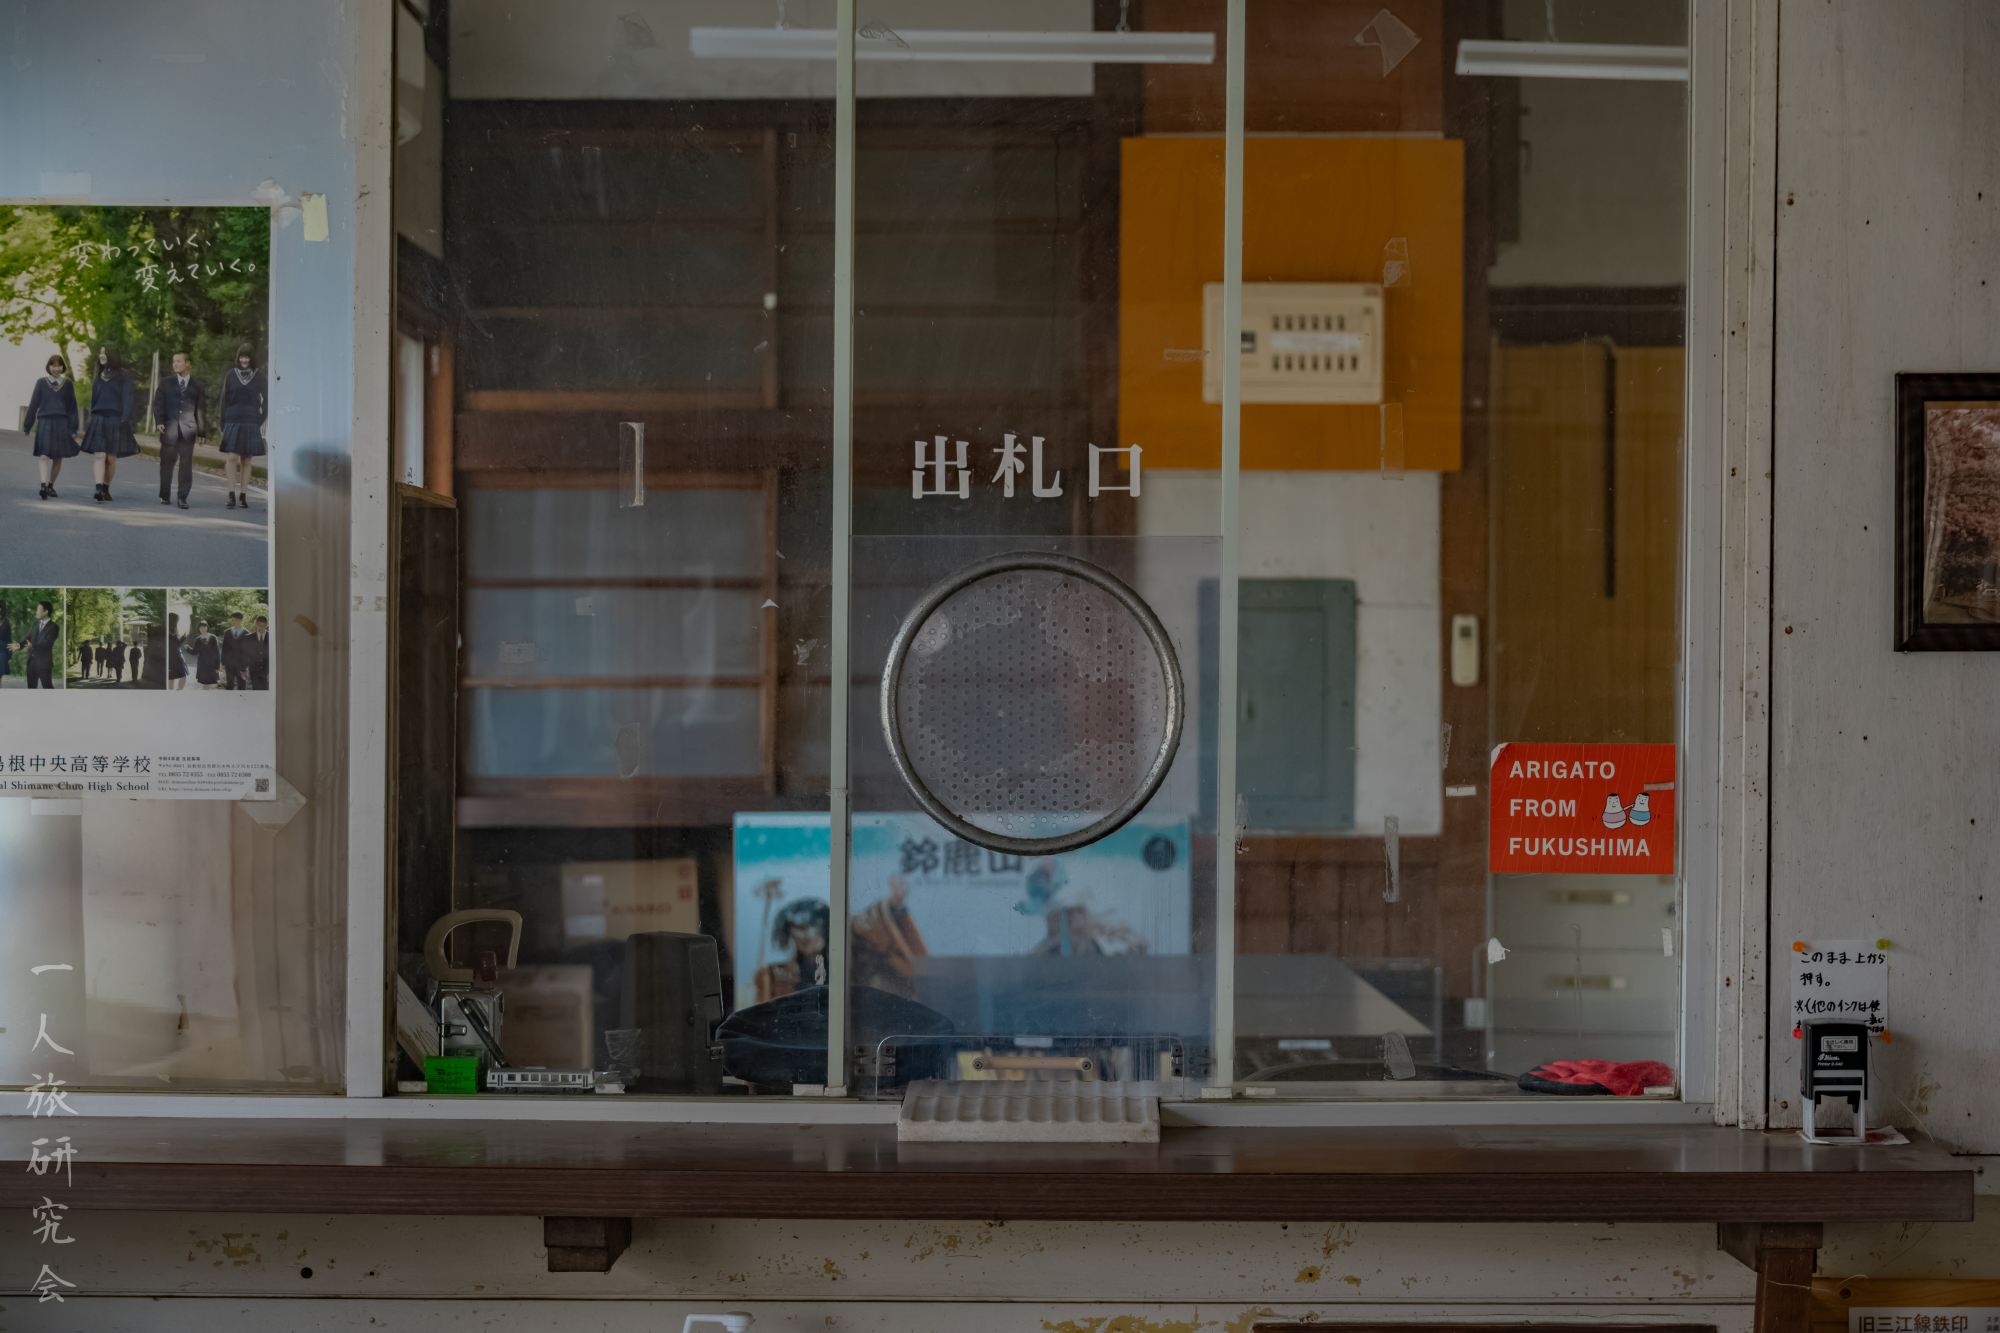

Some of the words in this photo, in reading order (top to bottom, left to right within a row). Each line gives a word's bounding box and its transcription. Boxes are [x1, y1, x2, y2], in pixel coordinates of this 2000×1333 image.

[70, 233, 212, 271] 変わっていく、
[135, 257, 256, 293] 変えていく。
[912, 433, 1143, 499] 出札口
[0, 754, 151, 773] 根中央高等学校
[1509, 760, 1616, 780] ARIGATO
[11, 781, 54, 790] Shimane
[57, 781, 84, 791] Chuo
[88, 781, 112, 793] High
[116, 782, 150, 792] School
[1509, 799, 1577, 818] FROM
[1509, 837, 1651, 857] FUKUSHIMA
[1800, 972, 1831, 987] 押す。
[1859, 1313, 1969, 1333] 旧三江線鉄印
